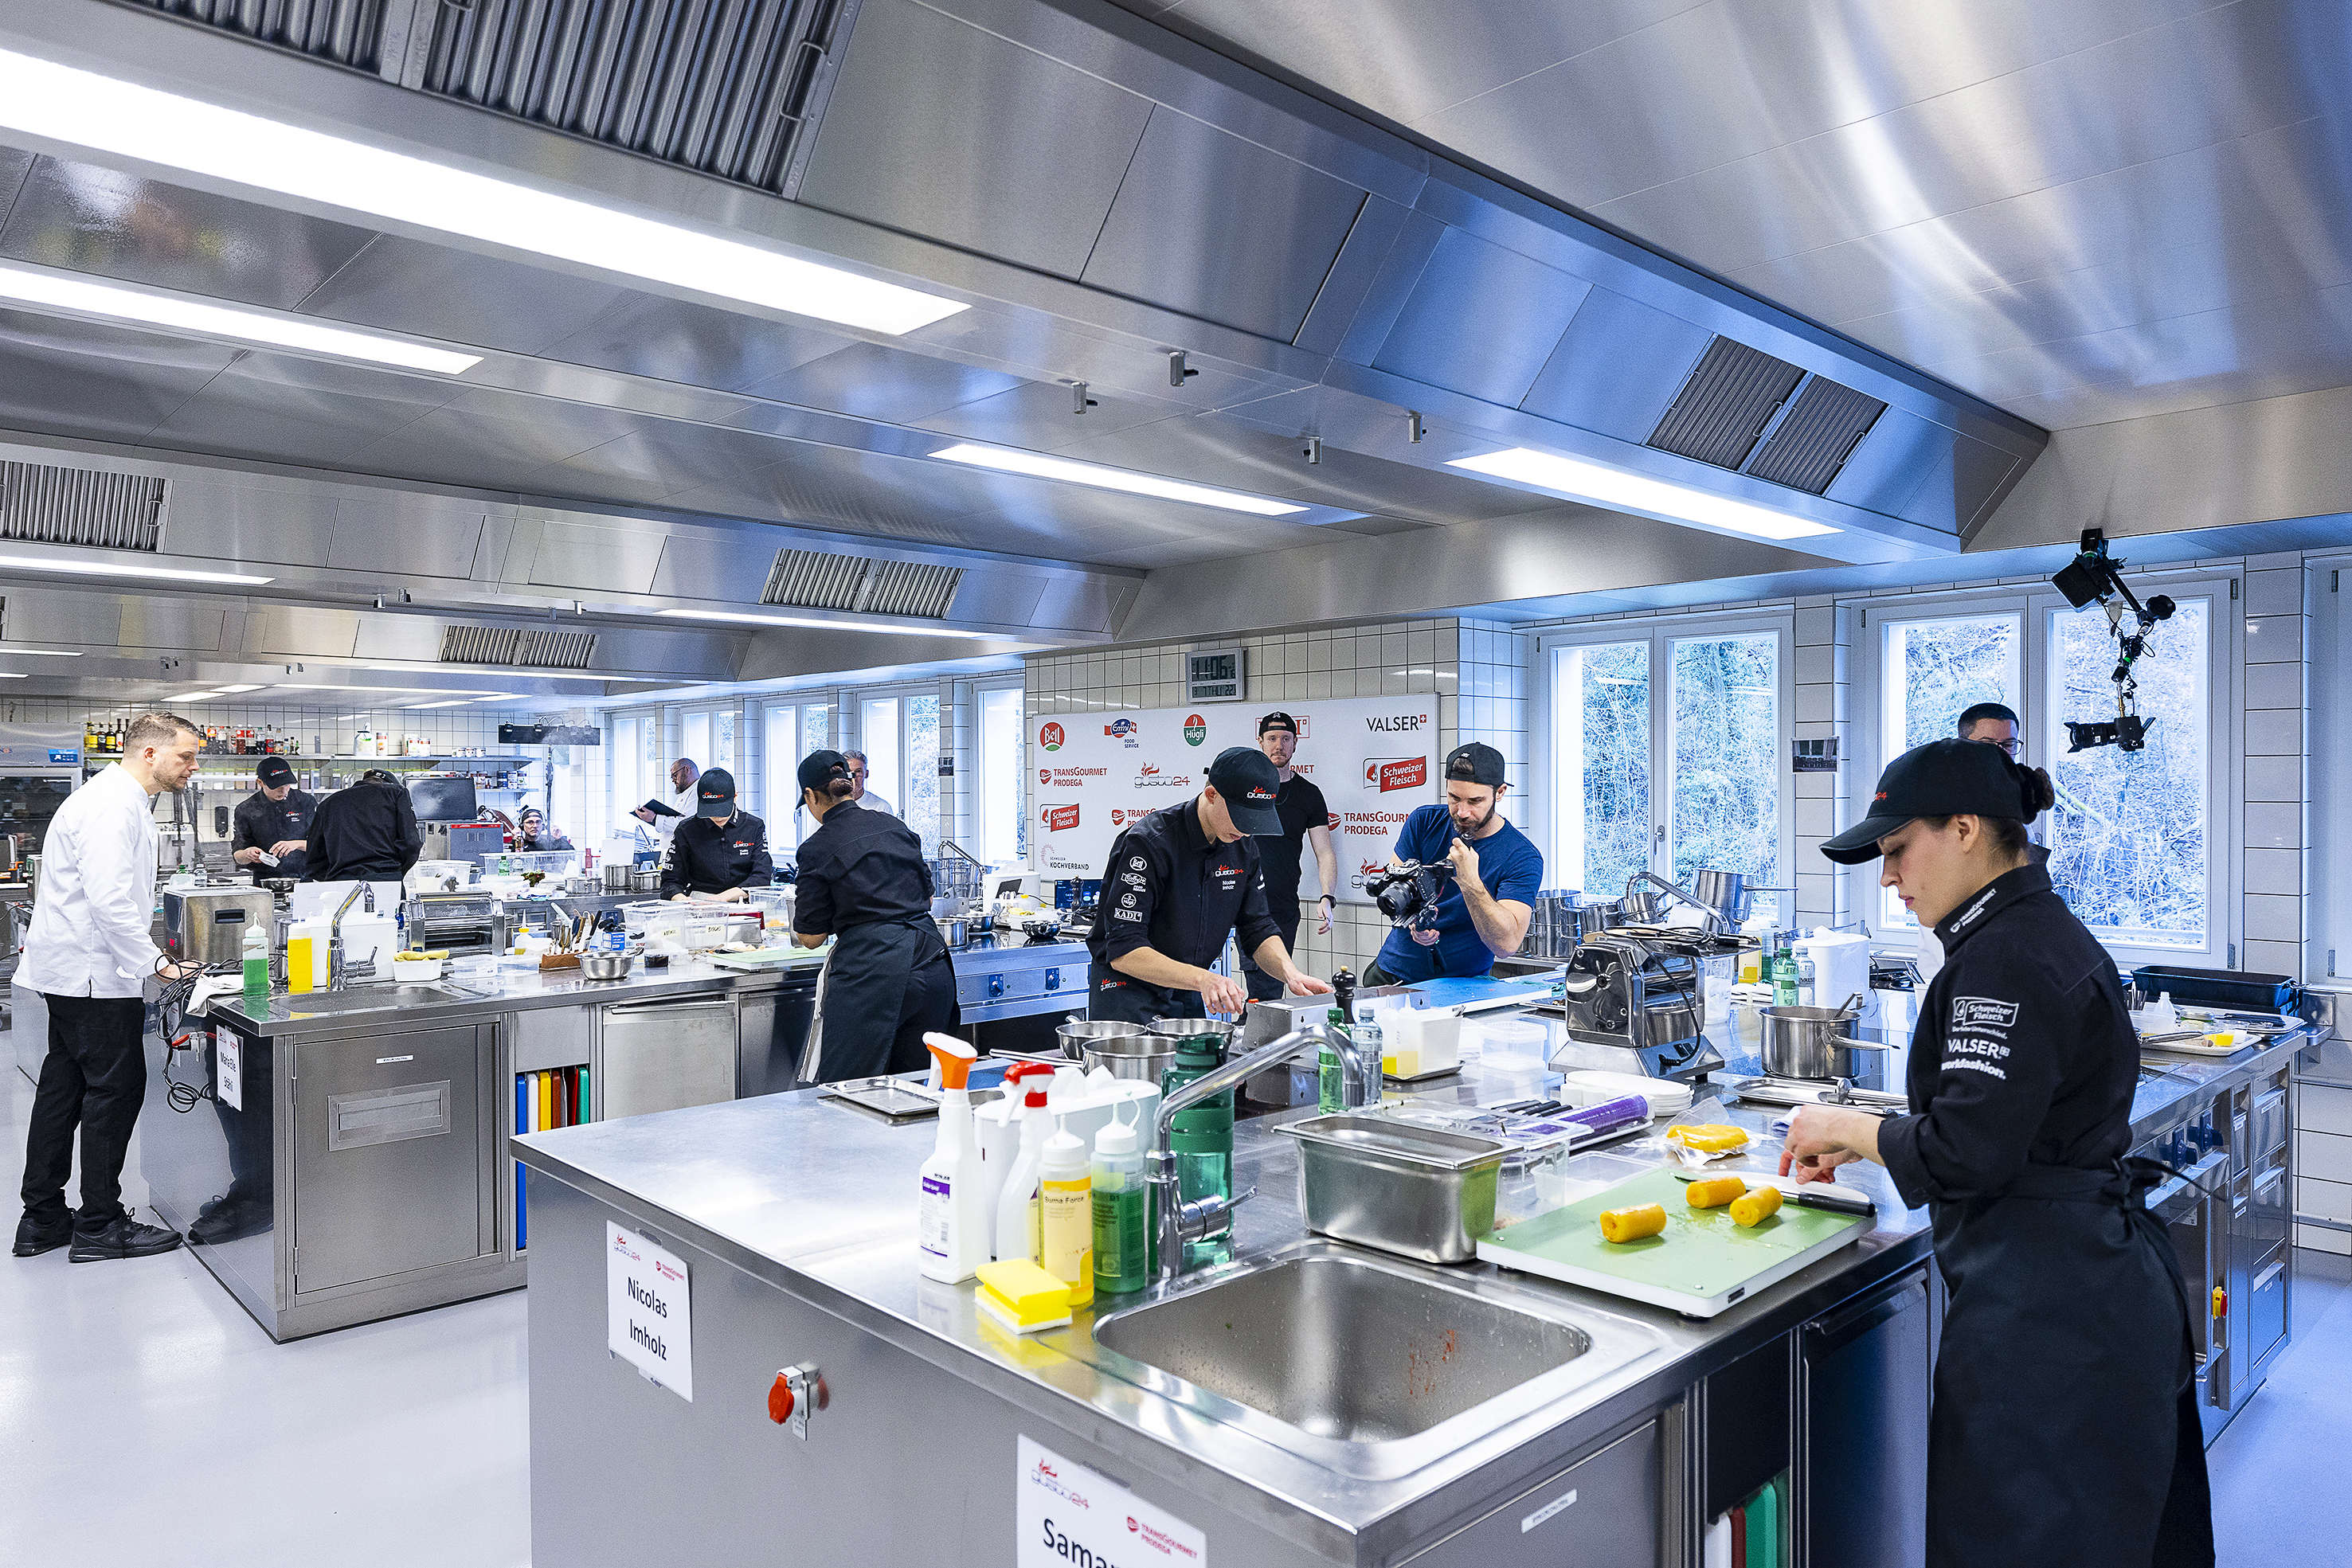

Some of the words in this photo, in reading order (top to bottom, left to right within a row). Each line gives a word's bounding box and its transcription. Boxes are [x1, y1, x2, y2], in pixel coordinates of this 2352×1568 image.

[1112, 721, 1130, 733] Emmi
[1366, 716, 1419, 731] VALSER
[1044, 727, 1060, 744] Bell
[1186, 729, 1204, 741] Hügli
[1054, 767, 1108, 776] TRANSGOURMET
[1383, 763, 1423, 778] Schweizer
[1133, 776, 1191, 788] gusto24
[1389, 773, 1417, 787] Fleisch
[1052, 808, 1078, 820] Schweizer
[1056, 817, 1074, 827] Fleisch
[1344, 825, 1388, 835] PRODEGA
[1050, 862, 1090, 870] KOCHVERBAND
[1116, 909, 1137, 921] KADI
[1968, 1004, 2013, 1015] Schweizer
[1973, 1012, 2004, 1022] Fleisch
[1947, 1038, 2000, 1060] VALSER
[628, 1277, 667, 1319] Nicolas
[629, 1318, 667, 1361] Imholz
